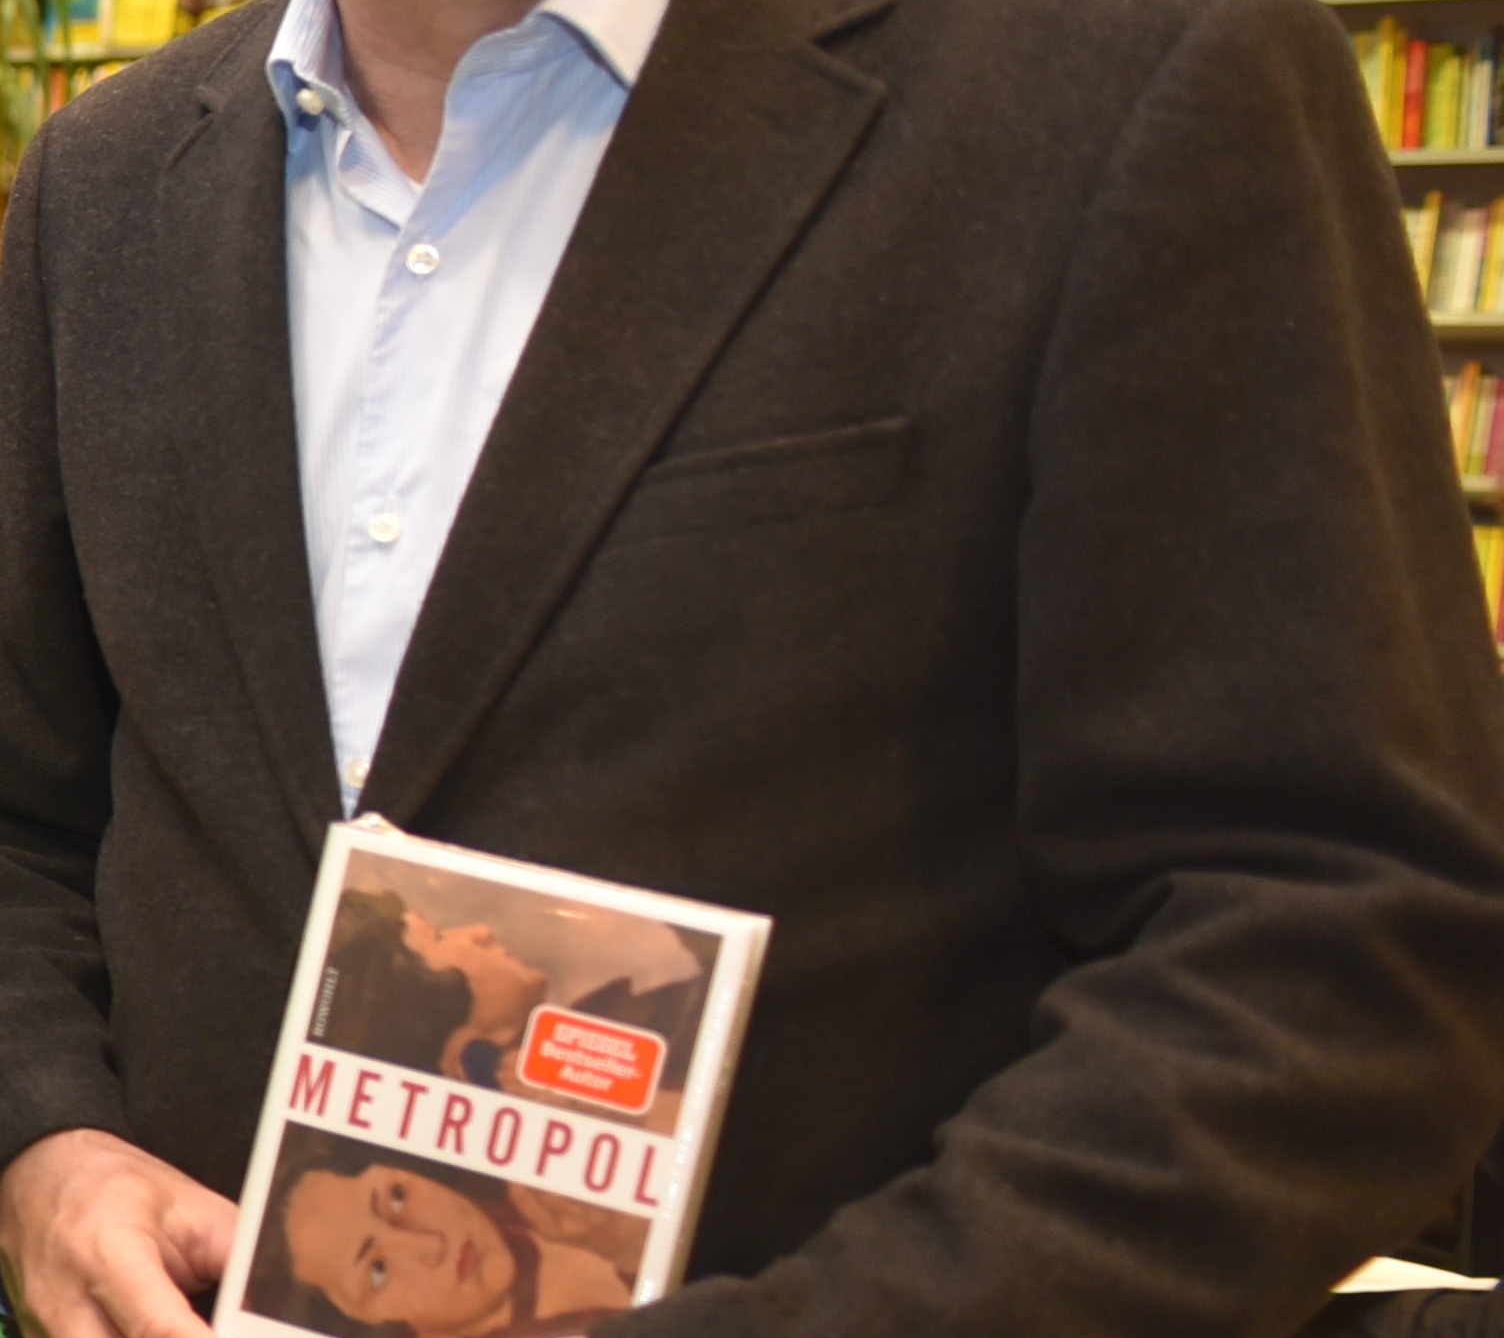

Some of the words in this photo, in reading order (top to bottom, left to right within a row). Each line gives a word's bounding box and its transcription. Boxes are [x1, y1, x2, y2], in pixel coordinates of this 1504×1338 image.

[313, 966, 340, 1038] ROWOHLT
[540, 1039, 642, 1081] Bestseller-
[552, 1022, 637, 1061] SPIEGEL
[559, 1065, 613, 1091] Autor
[289, 1053, 659, 1207] METROPOL
